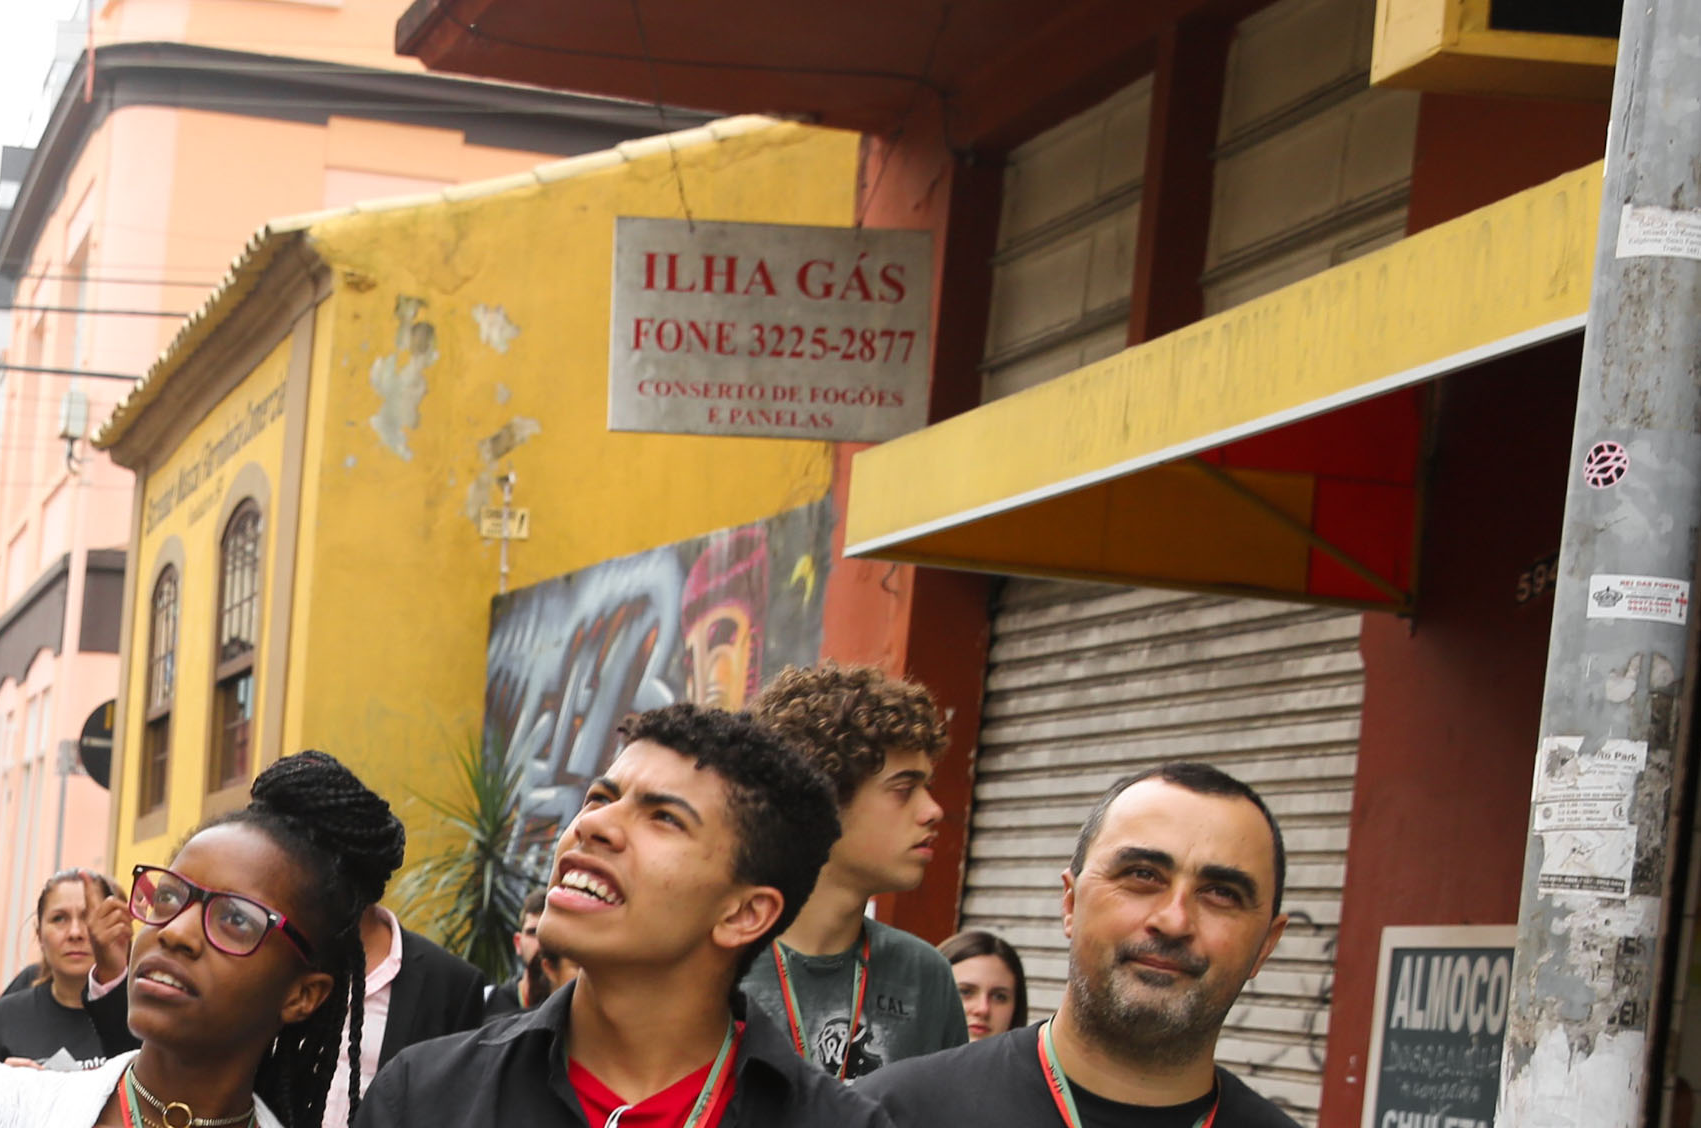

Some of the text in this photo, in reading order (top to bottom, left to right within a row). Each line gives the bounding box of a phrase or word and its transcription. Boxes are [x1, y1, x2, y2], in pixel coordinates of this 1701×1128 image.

[643, 252, 906, 304] ILHA GÁS
[632, 318, 916, 364] FONE 3225-2877
[638, 380, 904, 407] CONSERTO DE FOGÕES
[708, 407, 833, 428] E PANELAS
